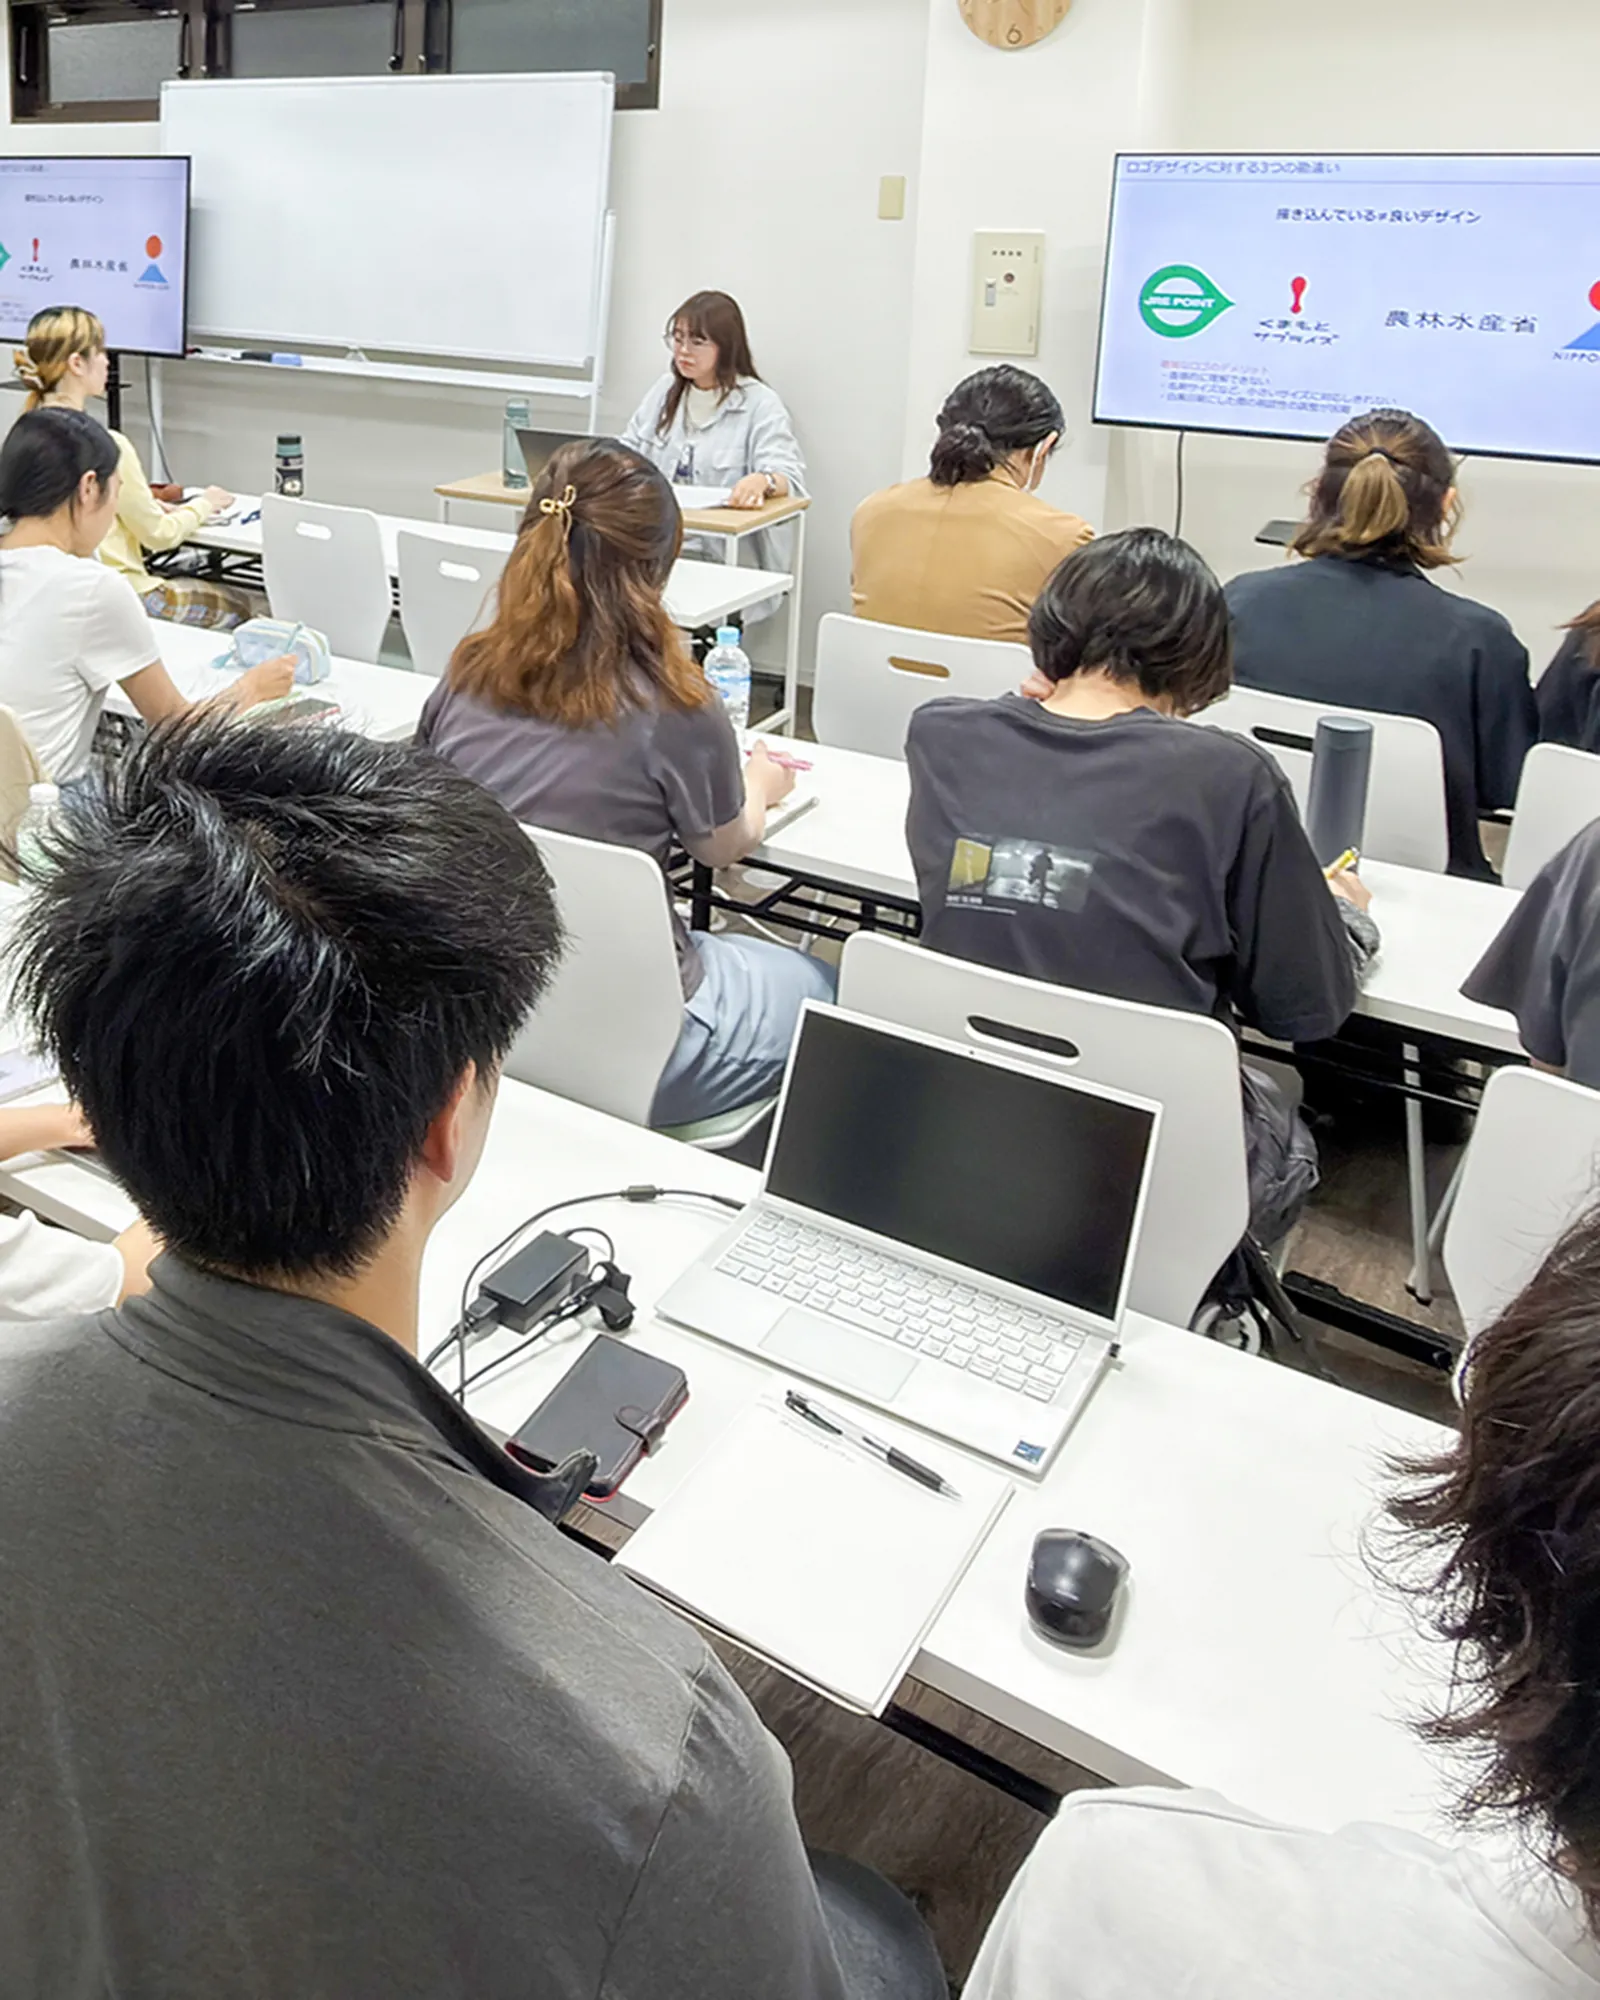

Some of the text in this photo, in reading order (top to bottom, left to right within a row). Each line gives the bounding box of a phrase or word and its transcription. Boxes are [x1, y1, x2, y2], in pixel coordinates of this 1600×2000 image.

[1006, 23, 1022, 45] 6
[1144, 296, 1216, 308] JRE POINT
[1259, 319, 1330, 332] くまもと
[1385, 309, 1539, 334] 農林水産省
